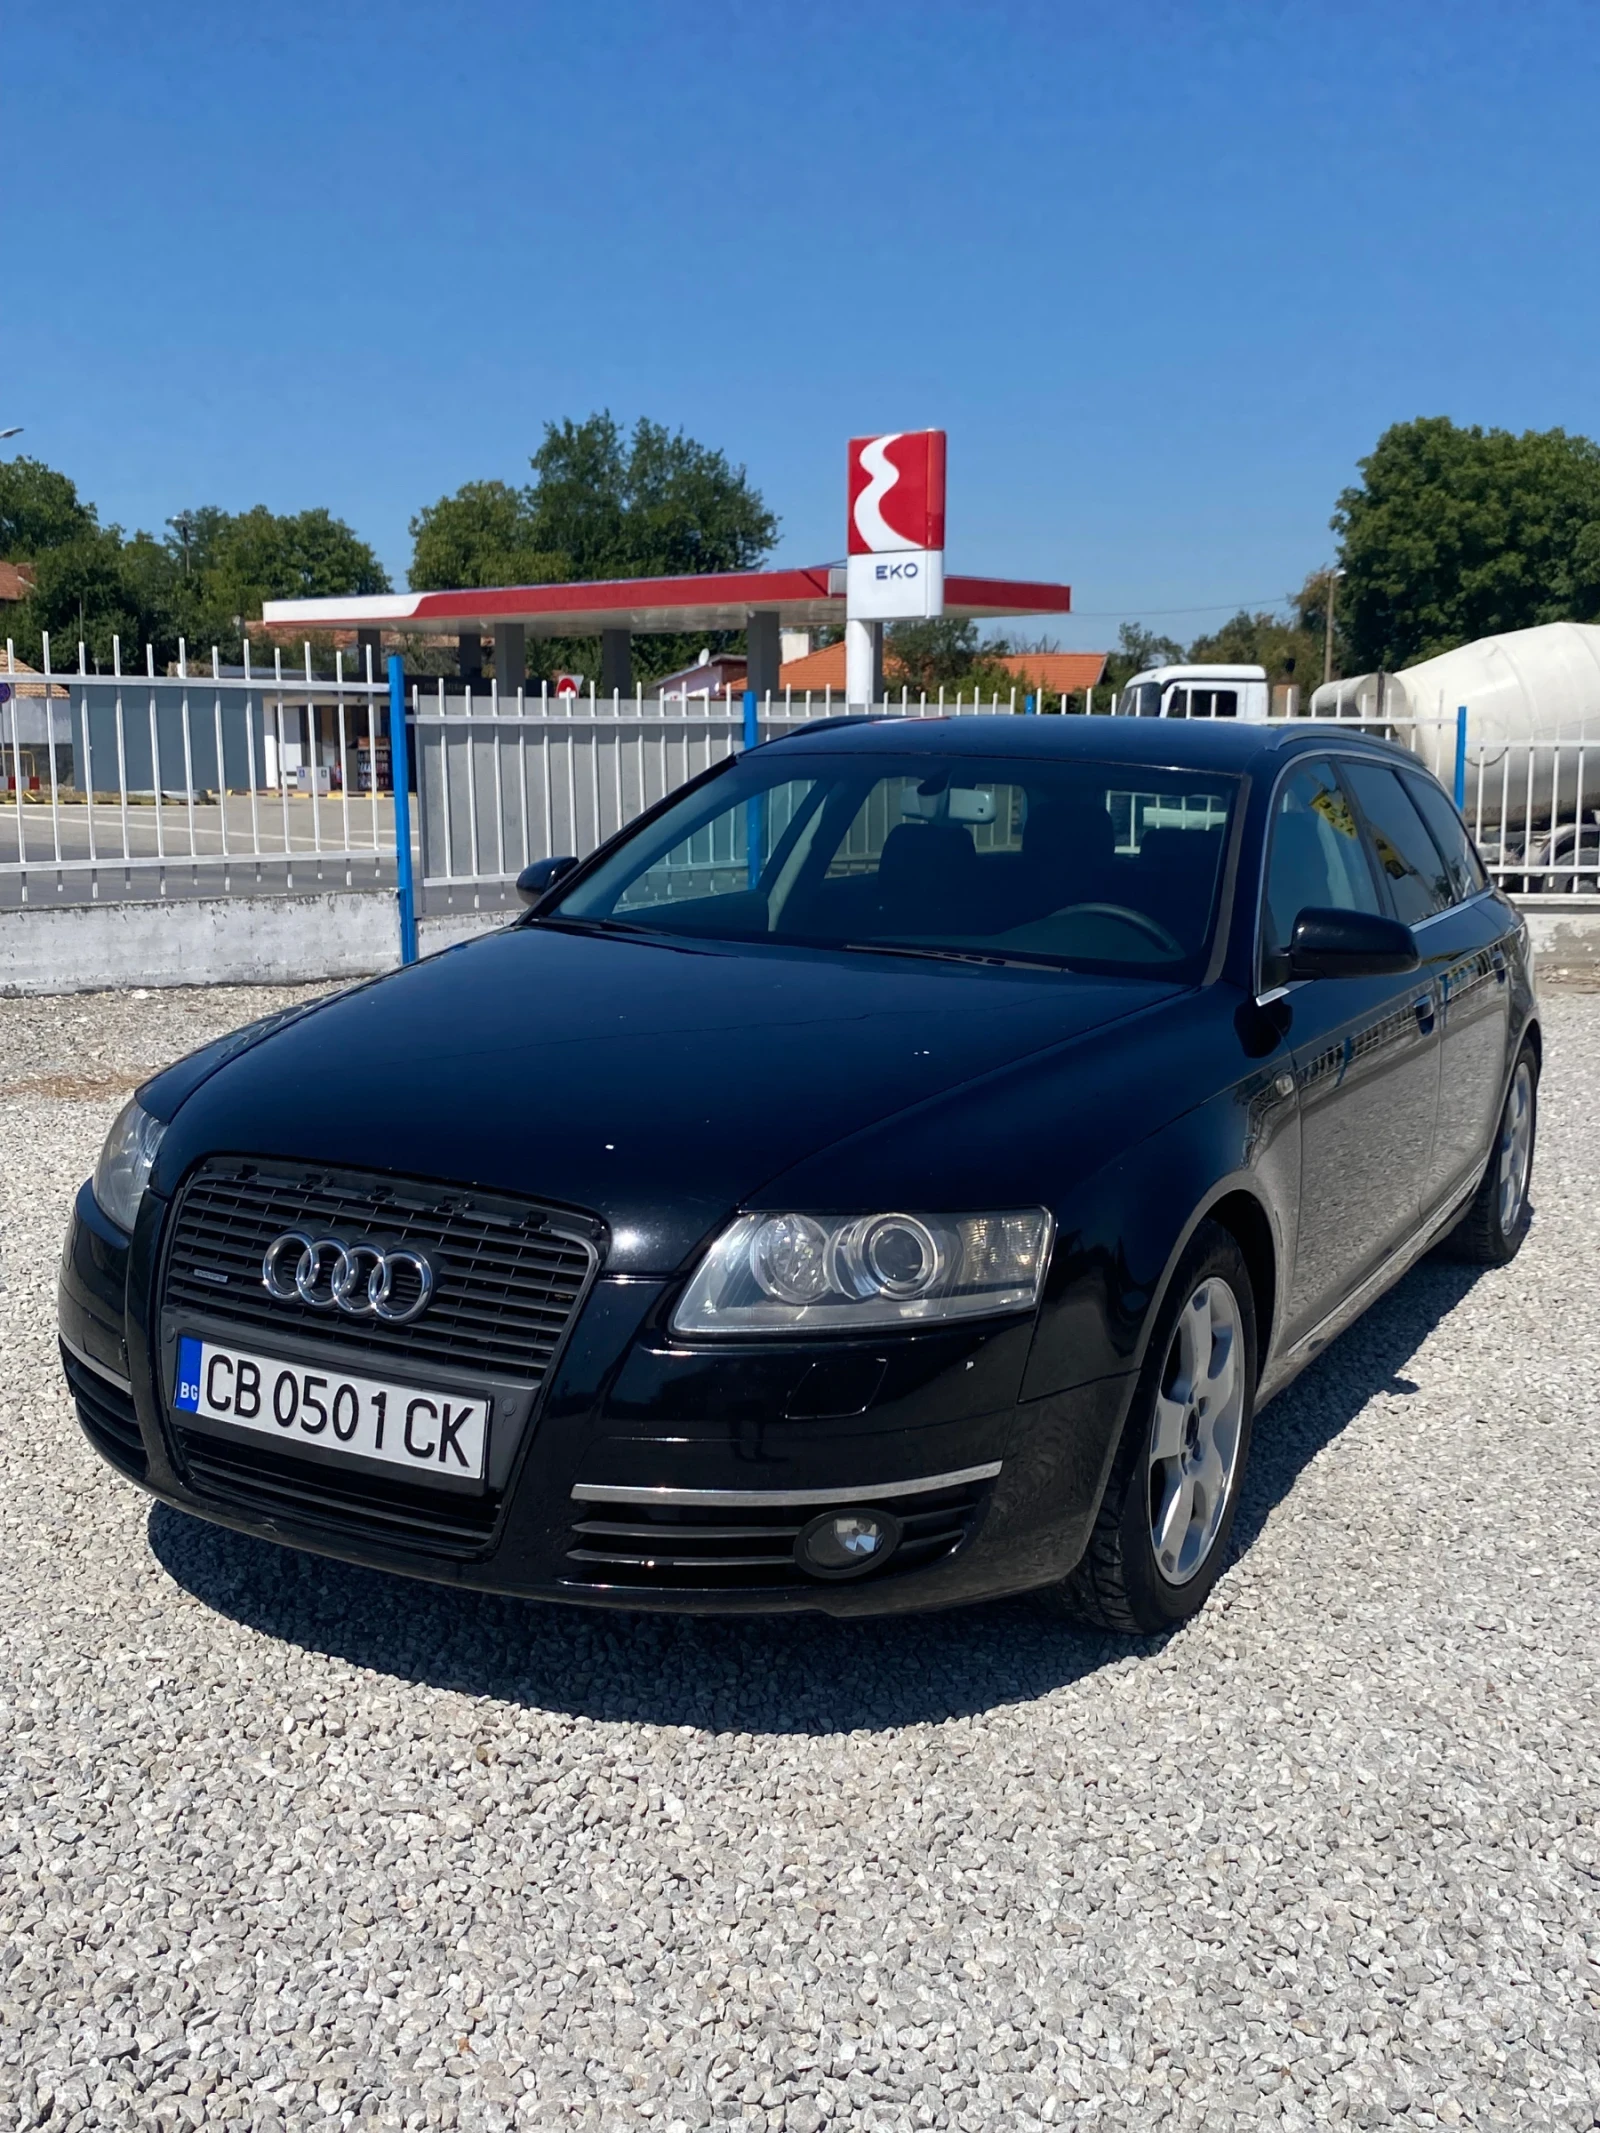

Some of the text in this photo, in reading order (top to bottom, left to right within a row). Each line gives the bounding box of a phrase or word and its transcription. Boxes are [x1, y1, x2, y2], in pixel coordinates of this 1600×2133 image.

[876, 562, 919, 580] EKO
[180, 1381, 199, 1401] BG
[206, 1354, 475, 1468] CB 0501 CK
